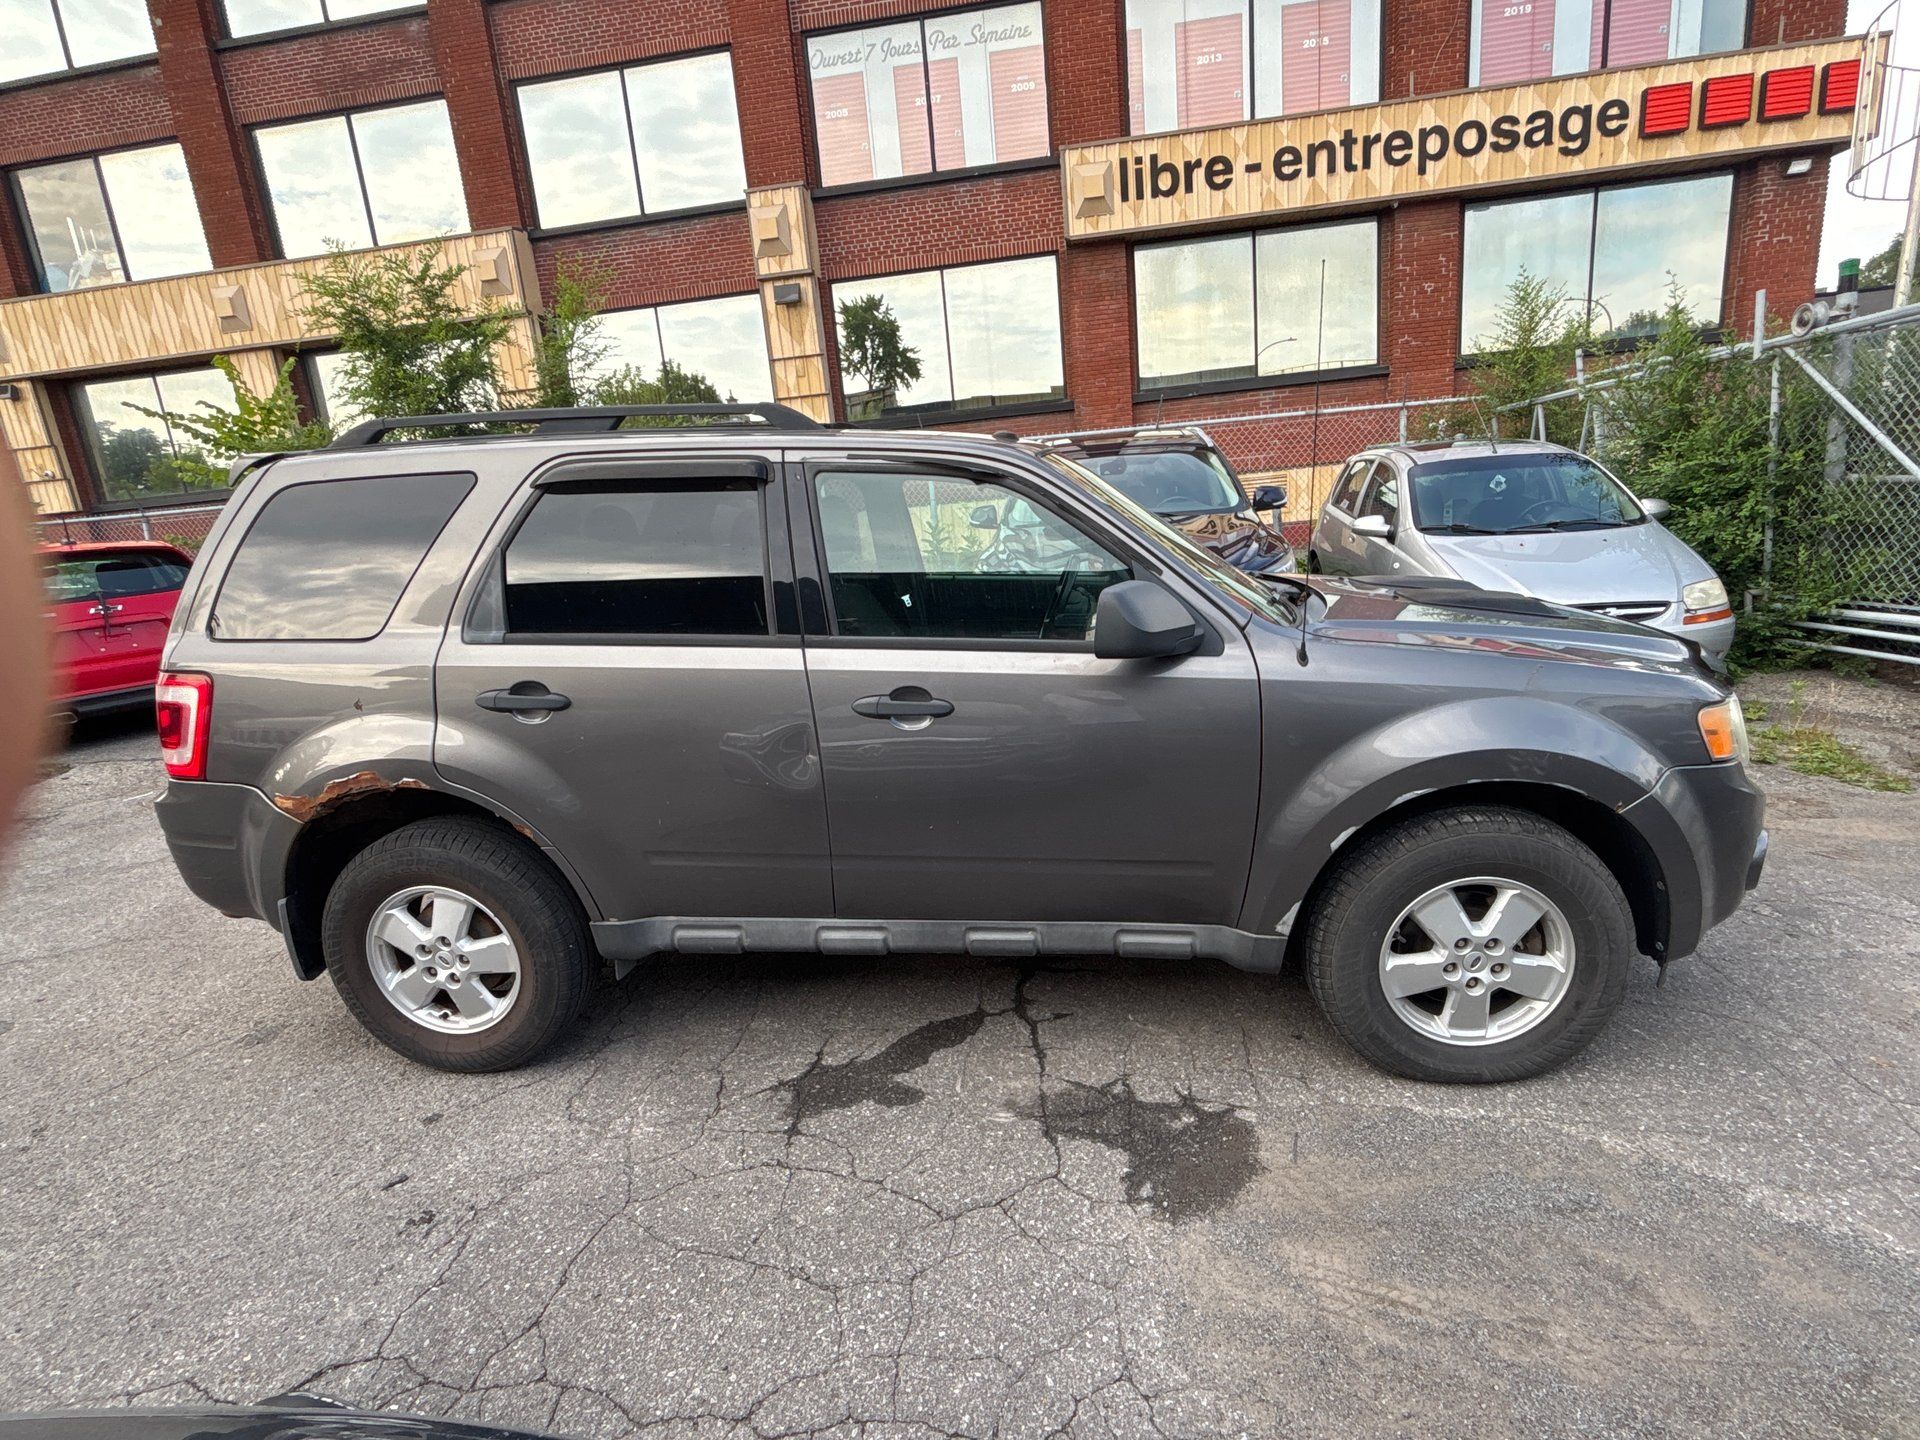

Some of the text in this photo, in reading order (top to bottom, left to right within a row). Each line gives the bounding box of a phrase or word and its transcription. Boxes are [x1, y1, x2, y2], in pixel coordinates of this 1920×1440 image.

[1504, 4, 1532, 17] 2019
[811, 23, 1032, 70] Ouvert 7 Jours Par Semaine
[1196, 53, 1222, 65] 2013
[1011, 81, 1035, 92] 2009
